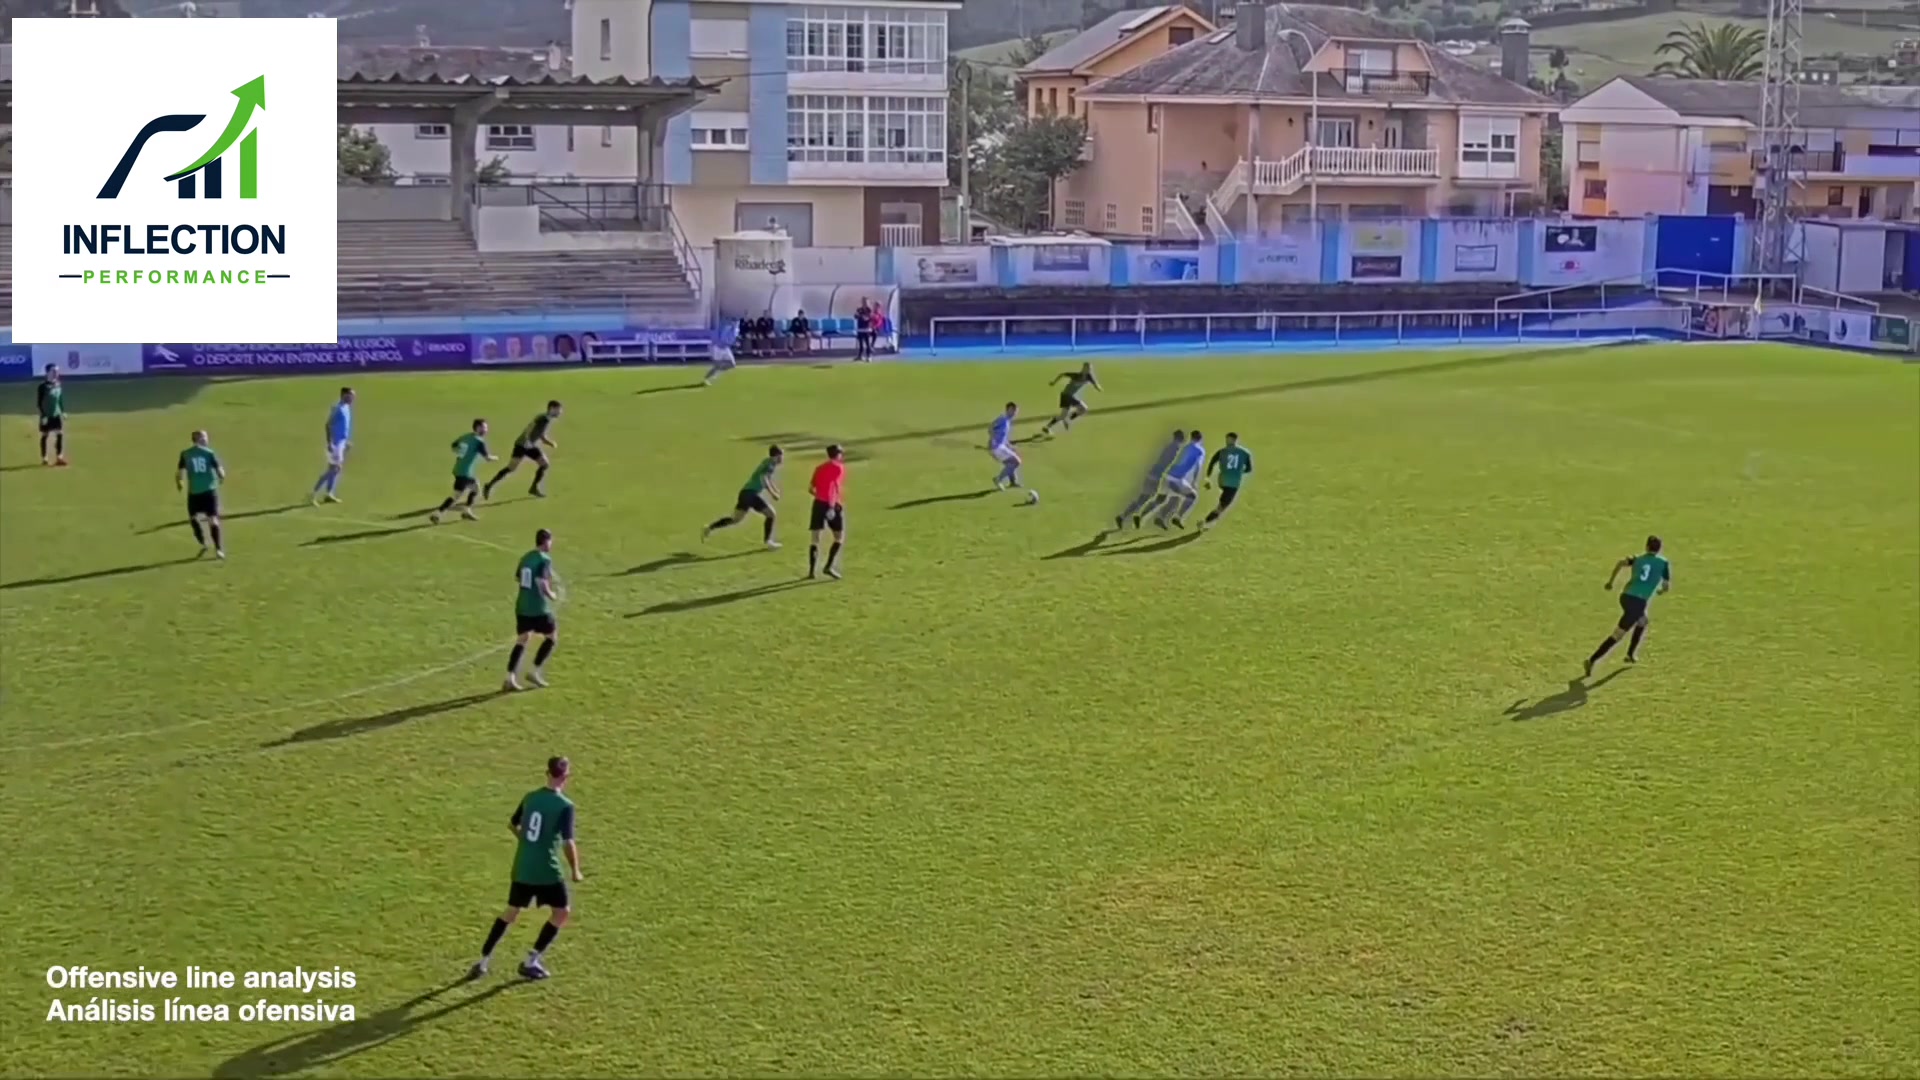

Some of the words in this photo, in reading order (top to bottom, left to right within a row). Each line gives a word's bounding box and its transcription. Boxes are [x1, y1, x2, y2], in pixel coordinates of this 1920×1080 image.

[1227, 453, 1239, 470] 21
[1640, 563, 1651, 582] 3
[526, 810, 542, 842] 9
